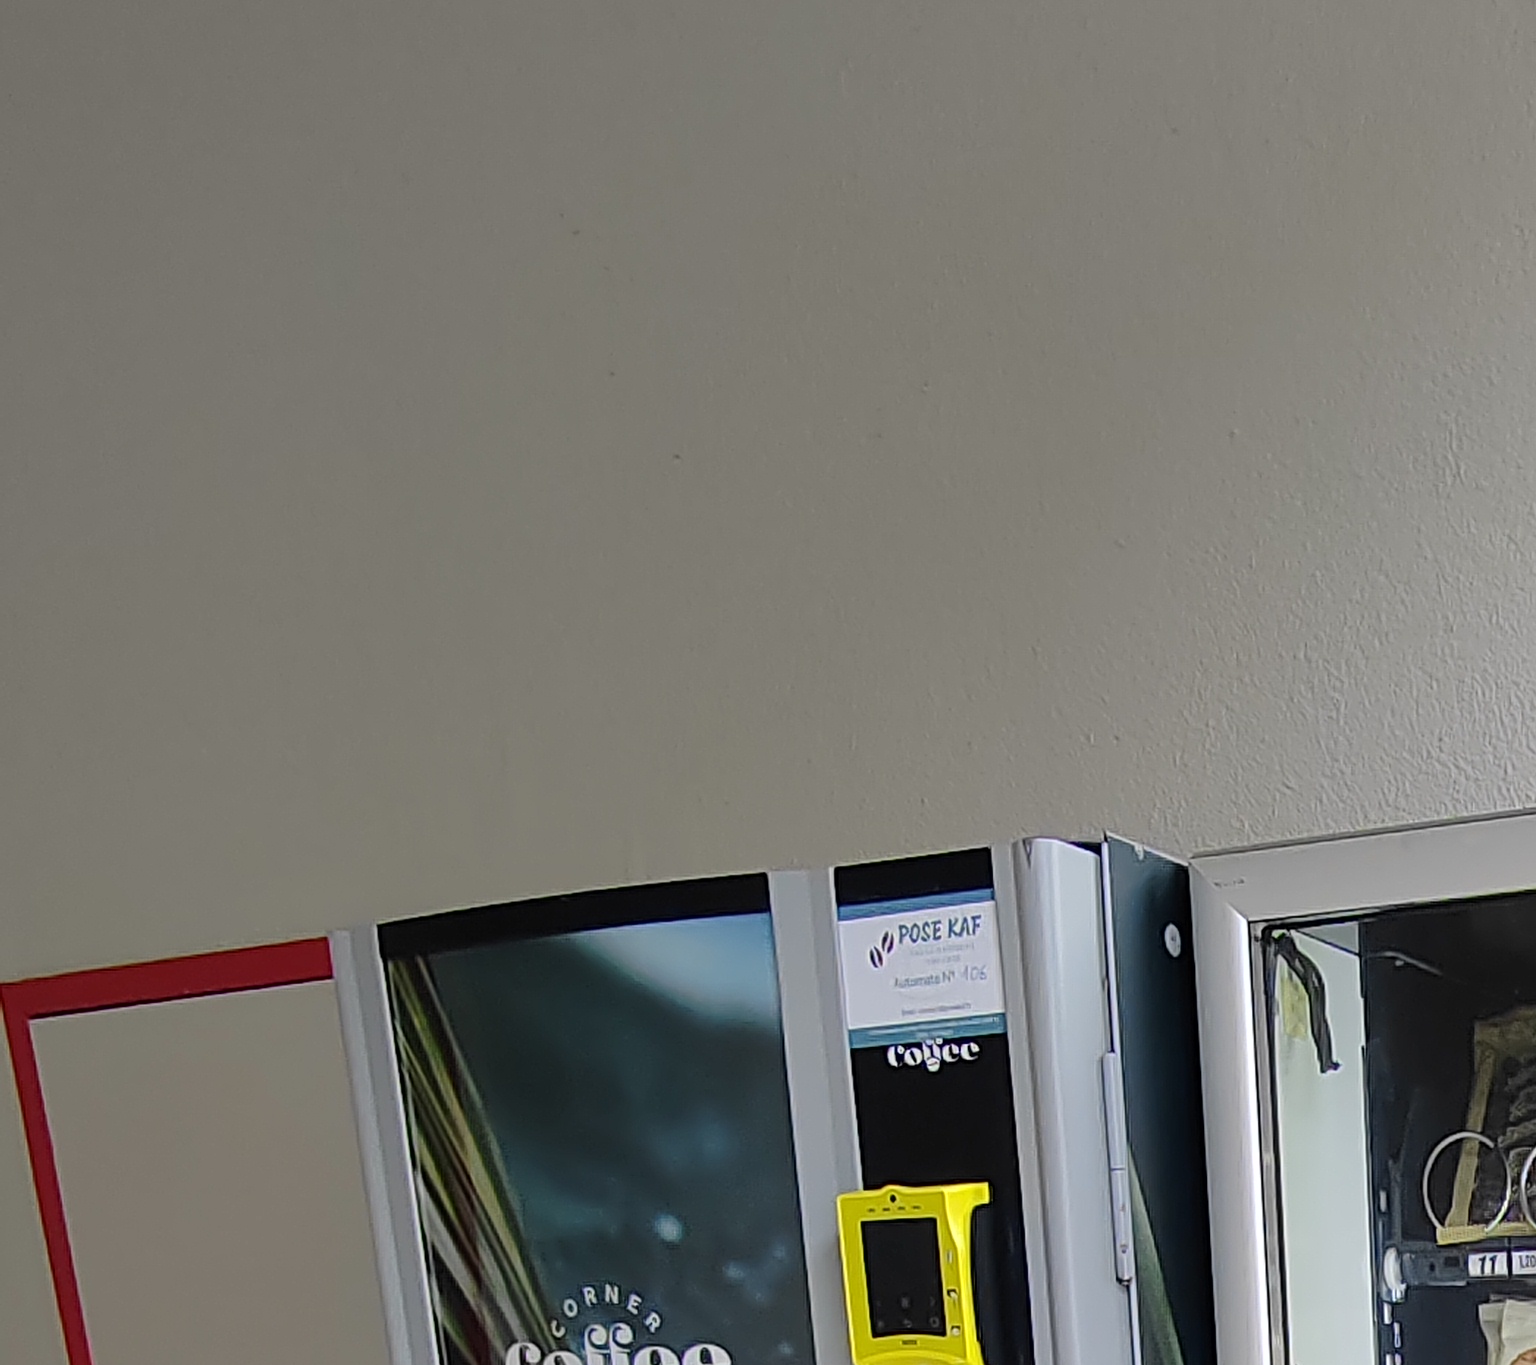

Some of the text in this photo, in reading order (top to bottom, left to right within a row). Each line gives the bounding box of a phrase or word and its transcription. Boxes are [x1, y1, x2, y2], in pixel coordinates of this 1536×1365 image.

[898, 915, 982, 944] POSE KAF
[1478, 1256, 1498, 1275] 11
[551, 1283, 662, 1338] CORNER
